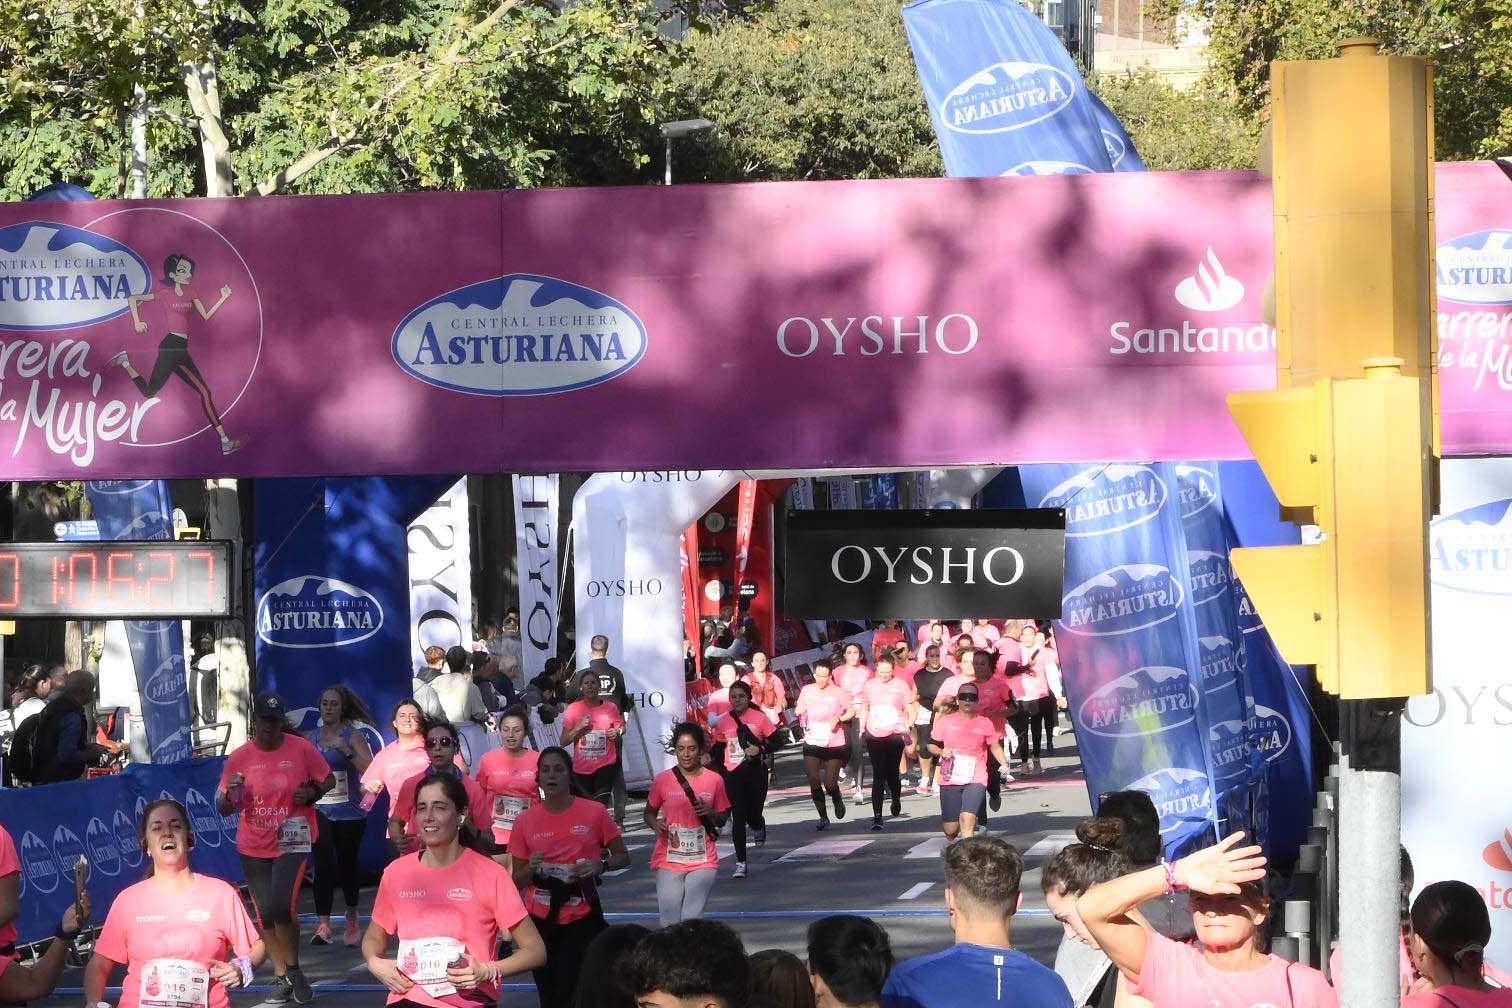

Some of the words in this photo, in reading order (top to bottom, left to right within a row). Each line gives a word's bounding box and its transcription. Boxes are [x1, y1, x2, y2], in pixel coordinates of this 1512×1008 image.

[53, 257, 126, 270] LECHERA
[451, 316, 531, 330] CENTRAL
[538, 314, 618, 328] LECHERA
[776, 313, 979, 358] OYSHO
[412, 321, 627, 366] ASTURIANA
[1110, 321, 1276, 355] Santand
[12, 373, 162, 468] Mujer
[831, 545, 1025, 587] OYSHO
[586, 578, 662, 598] OYSHO
[261, 605, 374, 633] ASTURIANA
[399, 890, 426, 898] OYSHO
